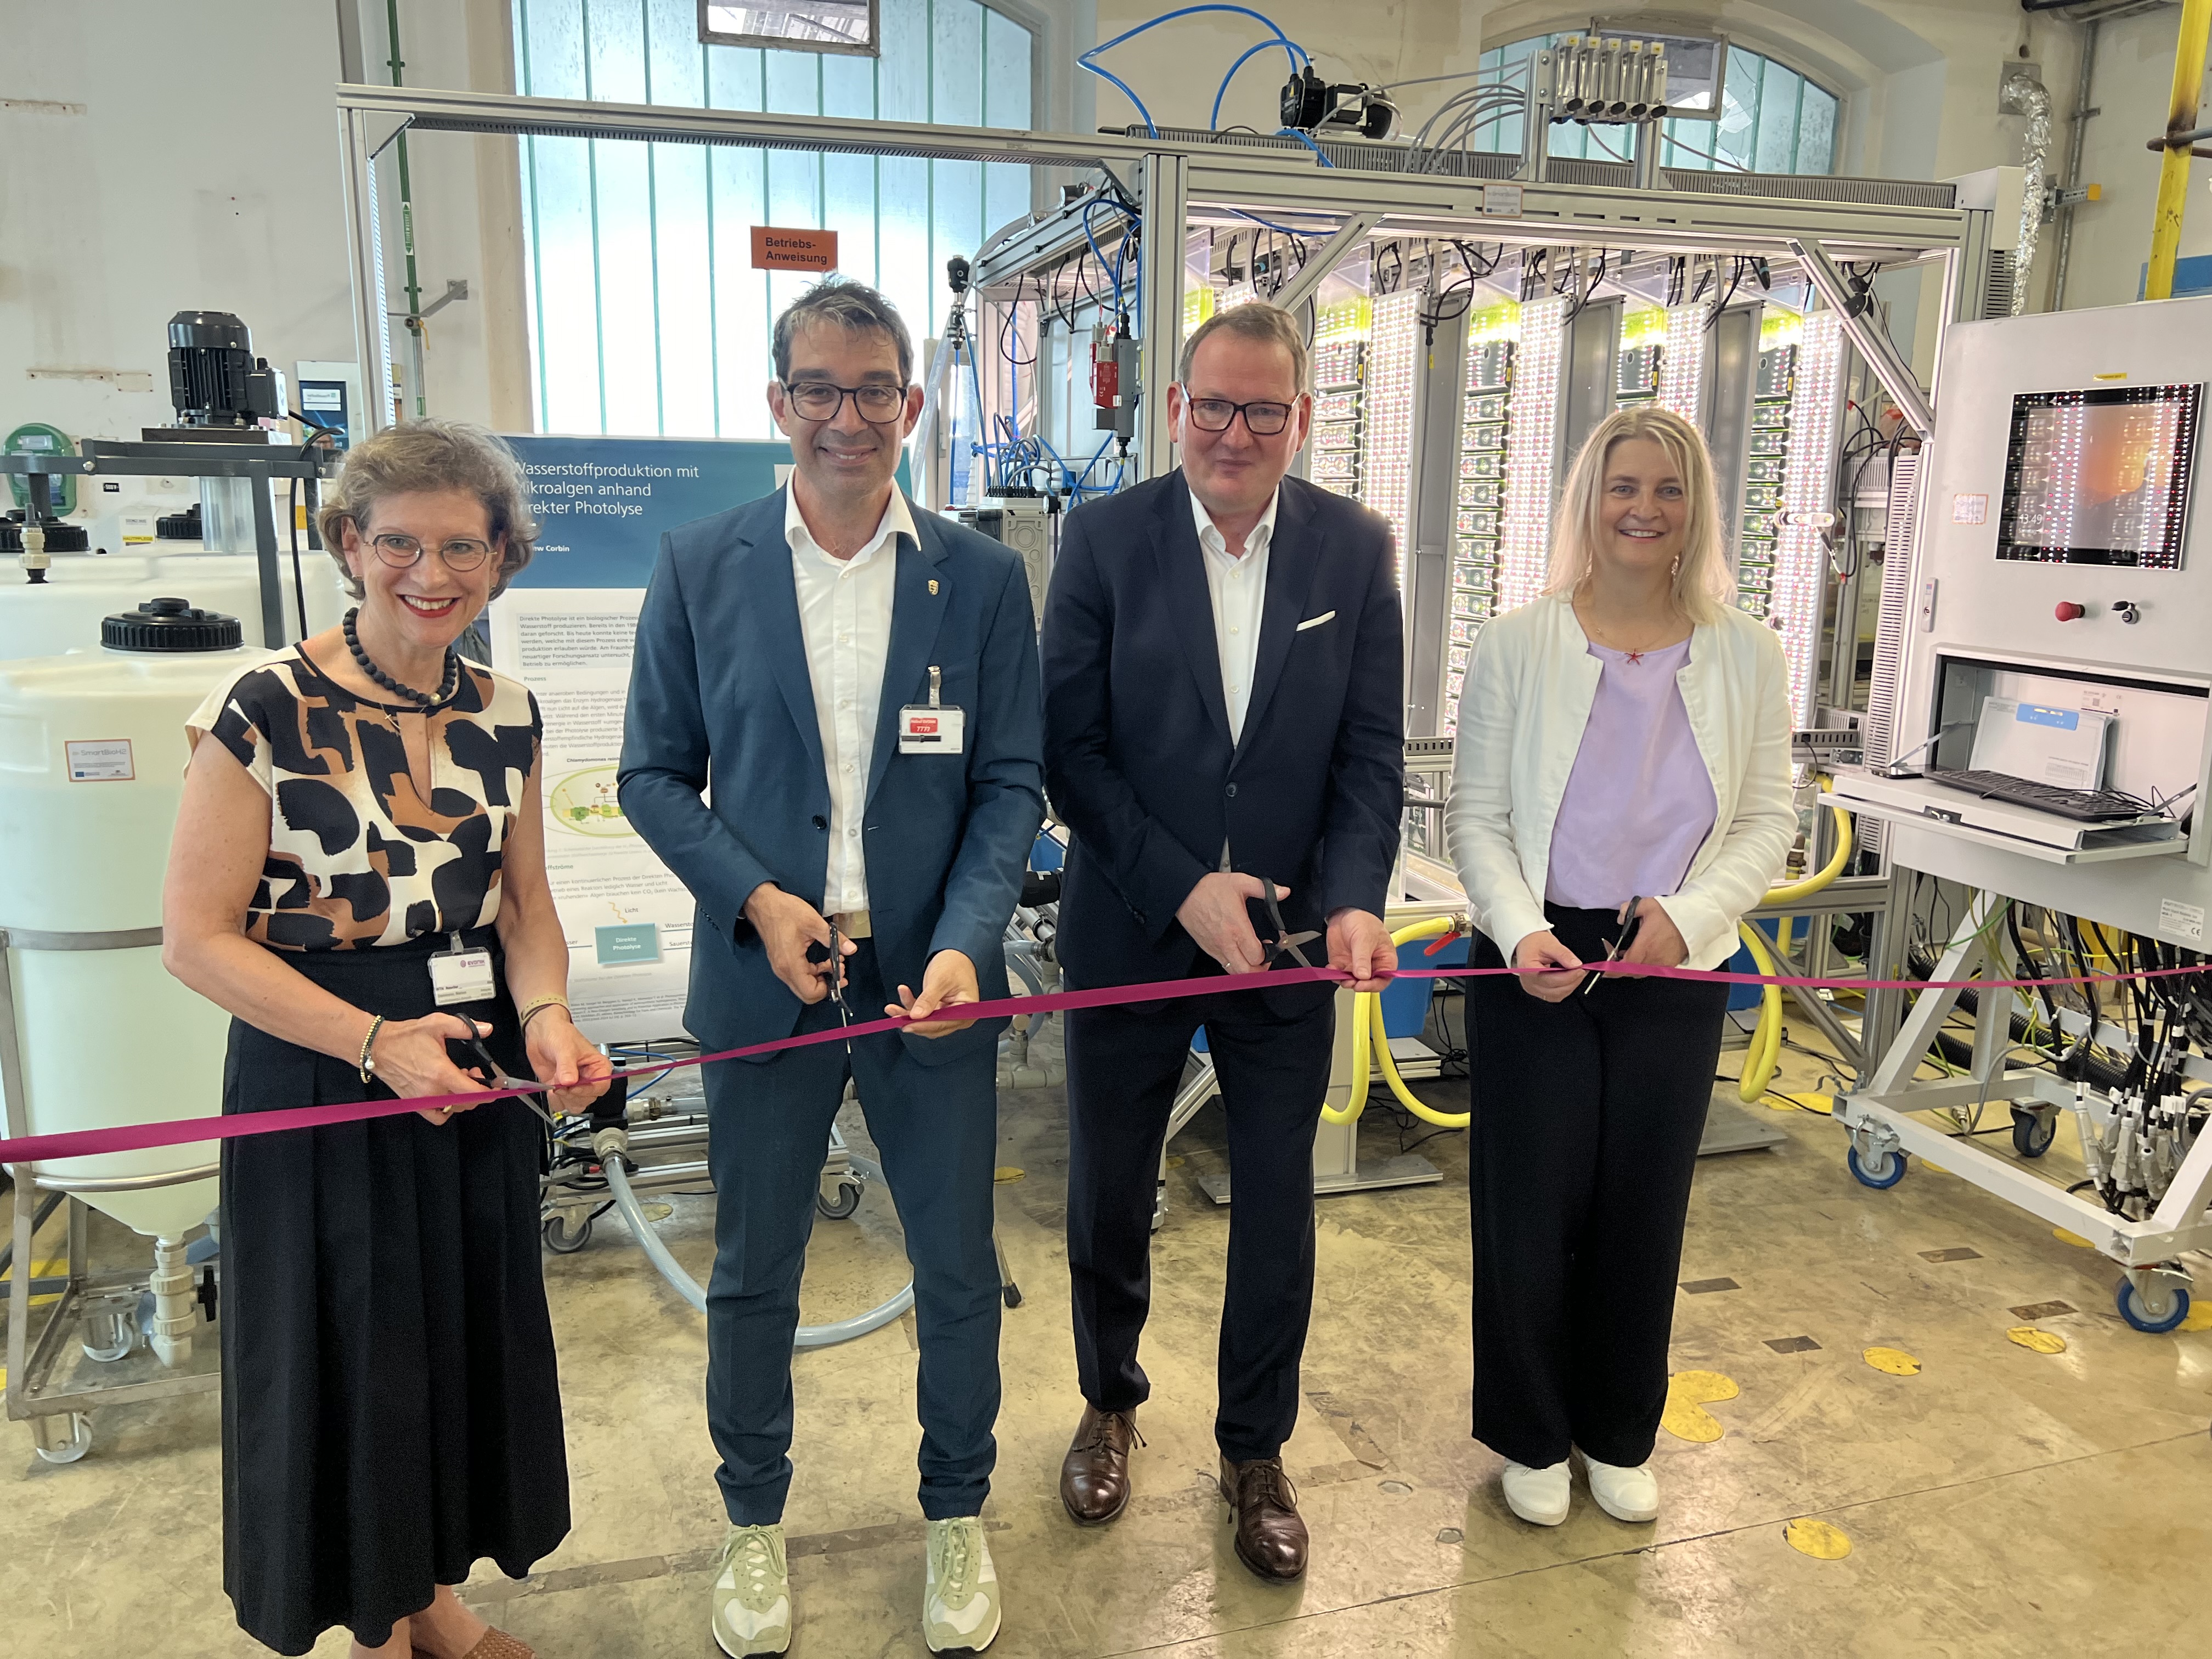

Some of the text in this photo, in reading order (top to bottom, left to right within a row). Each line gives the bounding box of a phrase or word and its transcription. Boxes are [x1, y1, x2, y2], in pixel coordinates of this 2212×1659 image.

[766, 237, 816, 249] Betriebs-
[766, 251, 827, 265] Anweisung
[676, 465, 699, 478] mit
[598, 483, 651, 496] anhand
[527, 500, 642, 518] rekter Photolyse
[2019, 514, 2042, 524] 13:49
